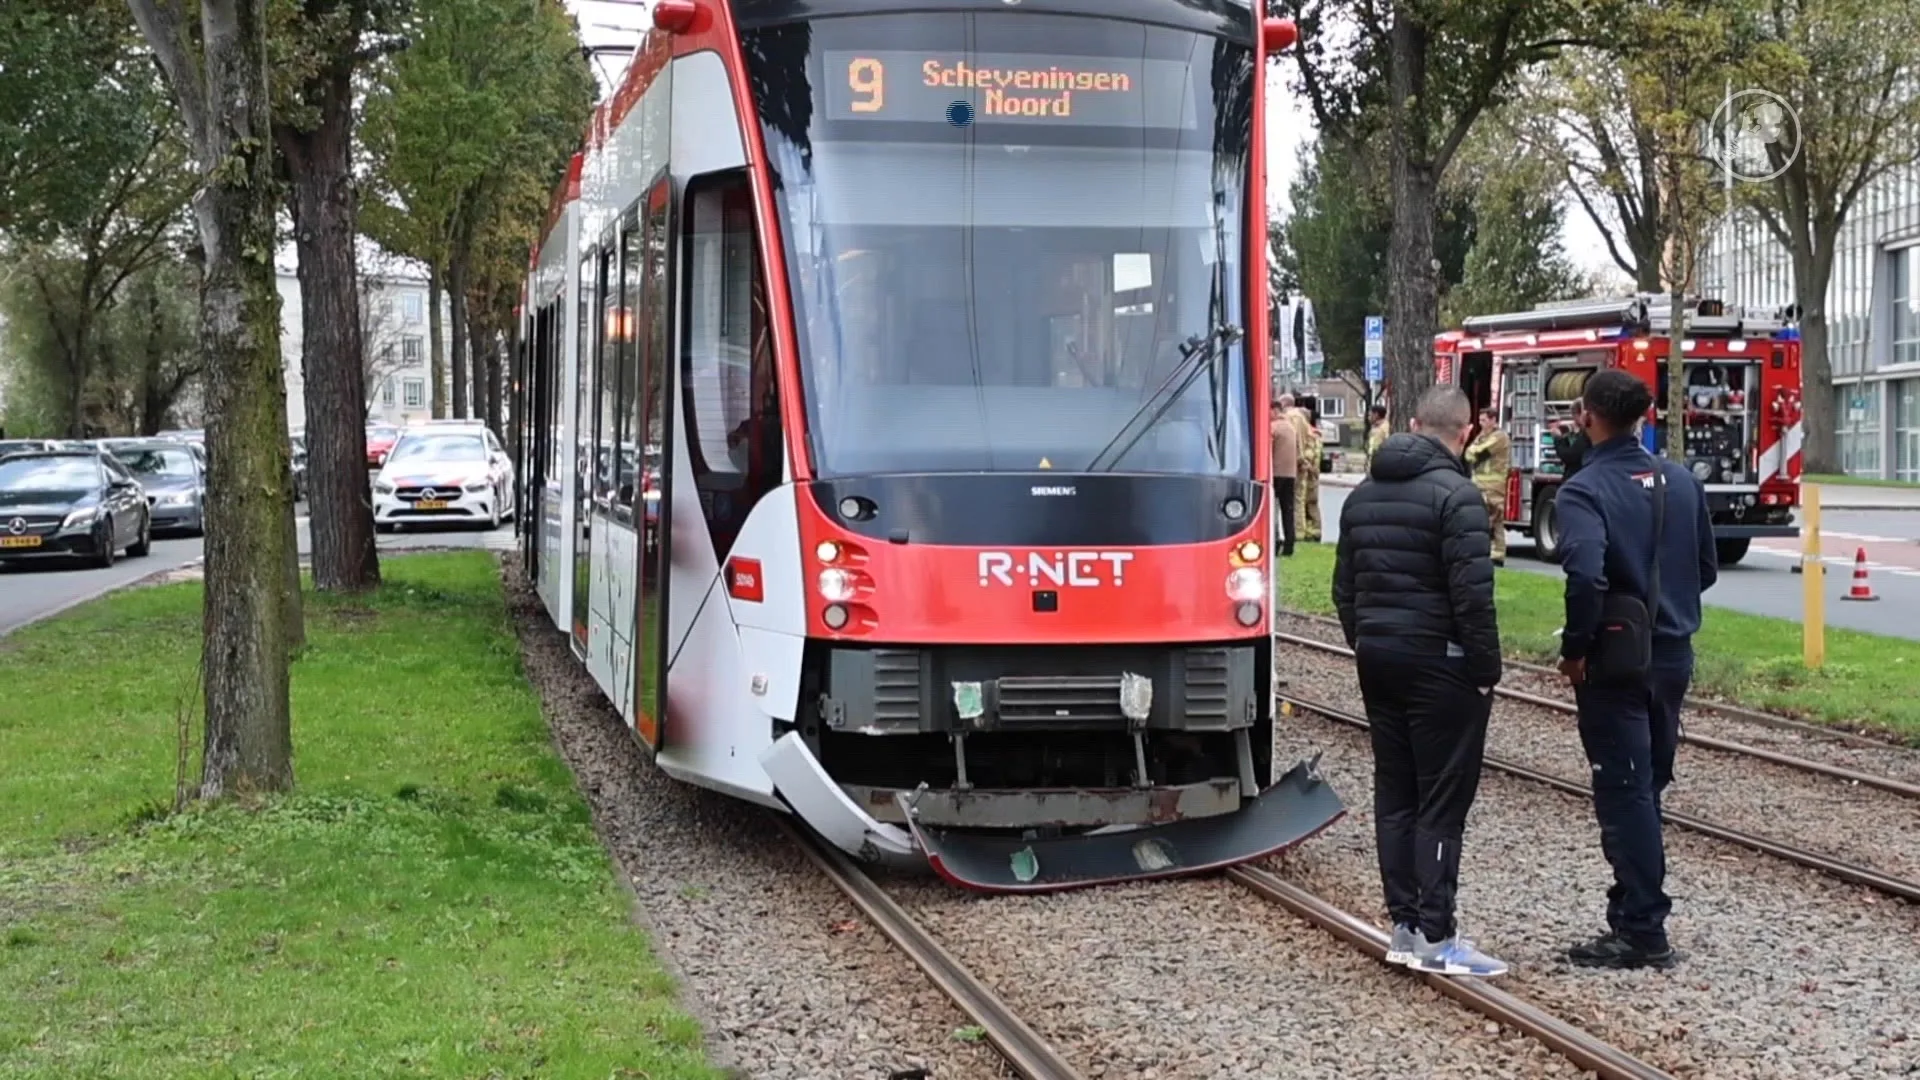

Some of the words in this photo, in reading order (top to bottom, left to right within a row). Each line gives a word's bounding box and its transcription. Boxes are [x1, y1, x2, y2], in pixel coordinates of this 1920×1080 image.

[849, 58, 883, 112] 9
[923, 60, 1129, 91] Scheveningen
[985, 89, 1071, 116] Noord
[1369, 319, 1379, 331] P
[1369, 358, 1378, 369] P
[1031, 486, 1077, 496] SIEMENS
